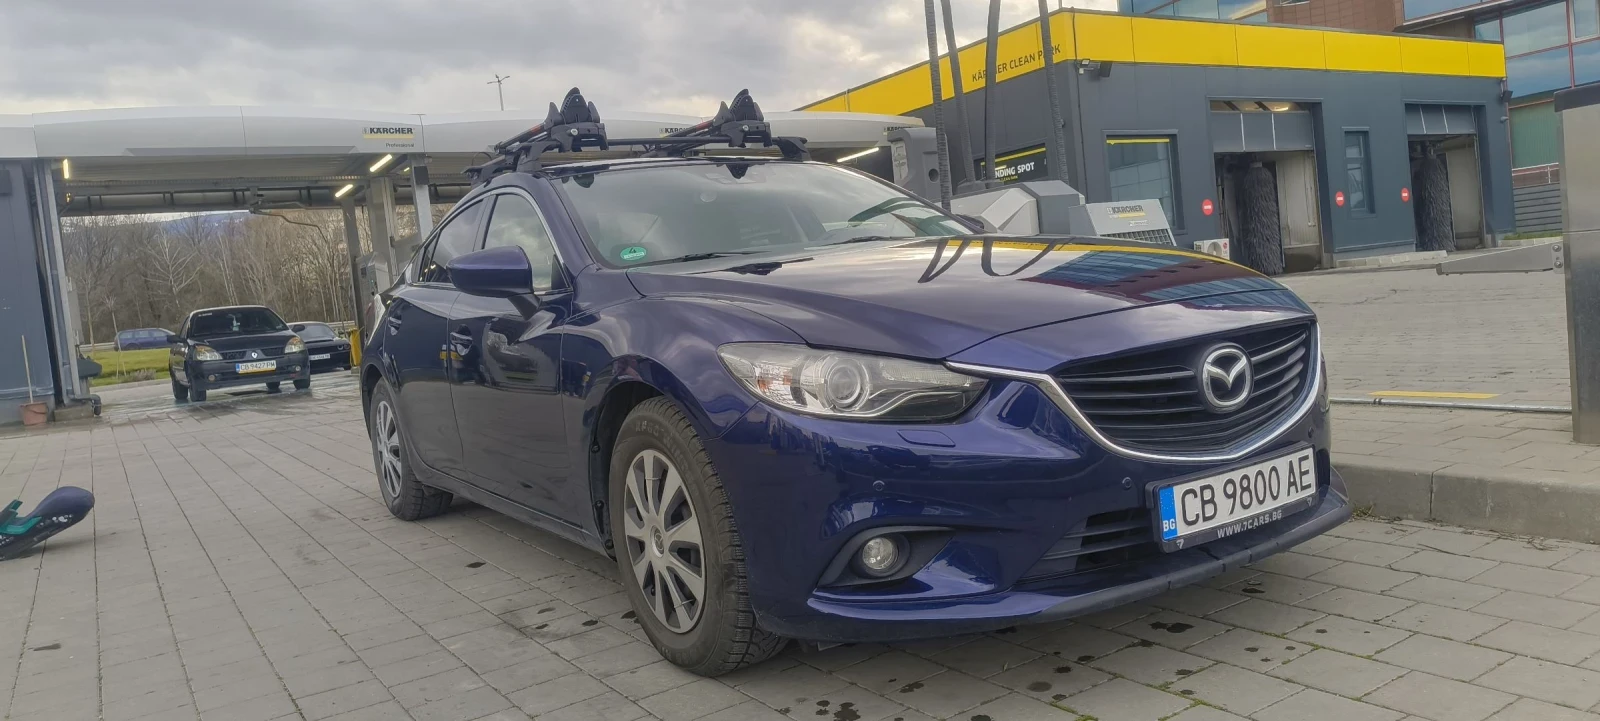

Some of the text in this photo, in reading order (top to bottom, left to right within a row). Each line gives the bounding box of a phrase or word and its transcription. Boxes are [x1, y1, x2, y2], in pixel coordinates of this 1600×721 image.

[972, 63, 1008, 82] KÄRER
[1009, 53, 1036, 69] CLEAN
[1017, 162, 1034, 174] SPOT
[1181, 454, 1312, 526] CB 9800 AE
[1162, 518, 1177, 532] BG
[1217, 509, 1283, 539] WWW.7CARS.BG
